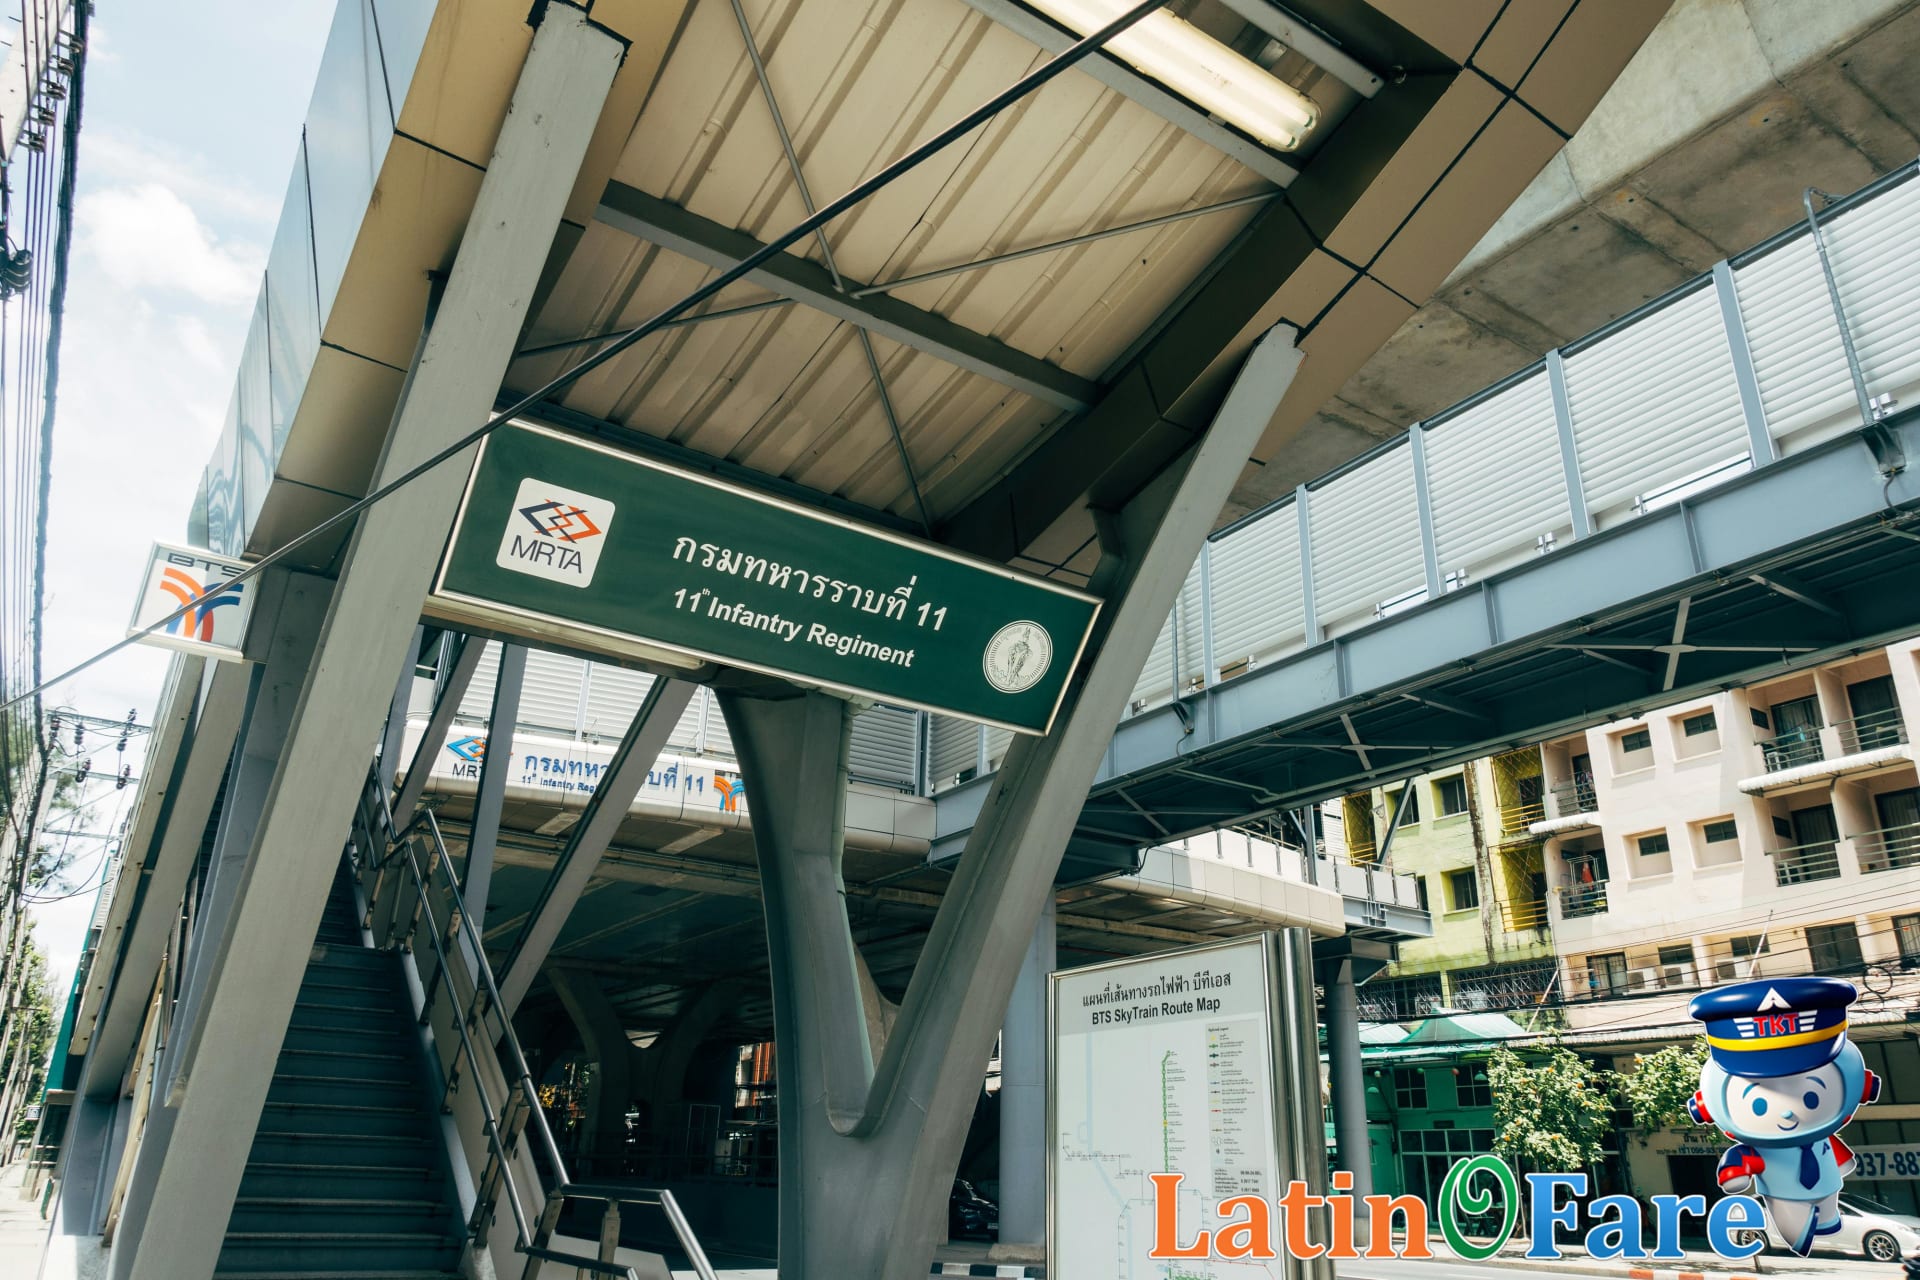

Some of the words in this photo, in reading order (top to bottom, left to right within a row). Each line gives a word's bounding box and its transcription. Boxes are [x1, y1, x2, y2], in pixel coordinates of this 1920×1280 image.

[167, 552, 246, 577] BTS
[510, 534, 582, 574] MRTA
[672, 536, 918, 621] กรมทหารราบที่
[917, 602, 948, 631] 11
[707, 596, 803, 642] Infantry
[806, 622, 915, 668] Regiment
[452, 763, 482, 779] MR
[685, 774, 704, 793] 11
[1092, 1010, 1112, 1025] BTS
[1114, 1004, 1159, 1024] SkyTrain
[1161, 1000, 1194, 1016] Route
[1196, 996, 1221, 1013] Map
[1854, 1151, 1920, 1177] 937-88
